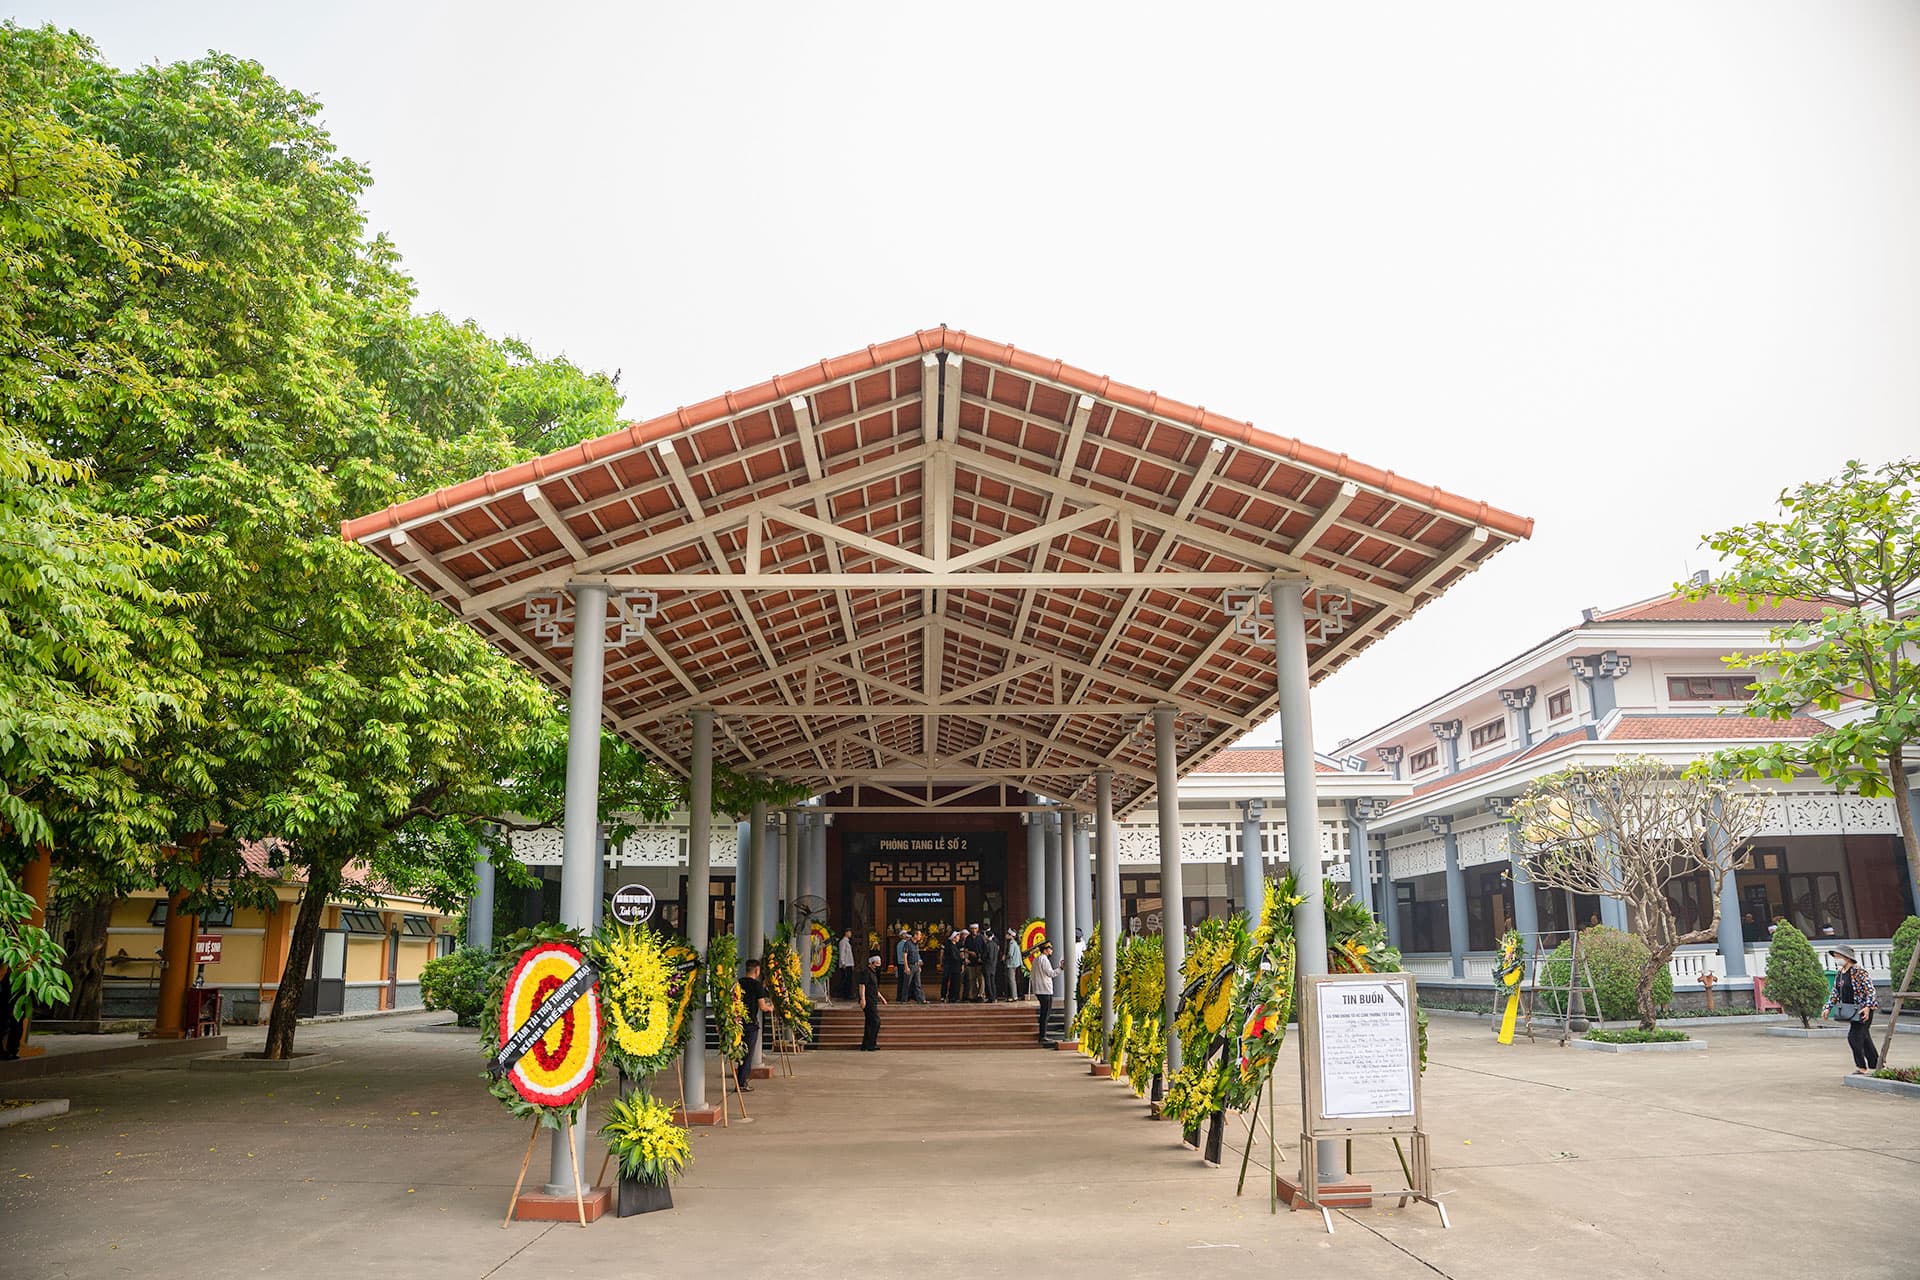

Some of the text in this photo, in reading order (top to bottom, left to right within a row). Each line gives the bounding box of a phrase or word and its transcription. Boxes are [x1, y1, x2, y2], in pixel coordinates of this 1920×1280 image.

[911, 840, 933, 850] TANG
[947, 837, 960, 850] SỐ
[961, 840, 968, 850] 2
[538, 1001, 554, 1018] TRỢ
[549, 977, 578, 1004] THƯƠNG
[574, 965, 592, 980] MẠI
[1342, 994, 1357, 1005] TIN
[519, 1027, 545, 1054] KÍNH
[542, 998, 574, 1028] VIẾNG
